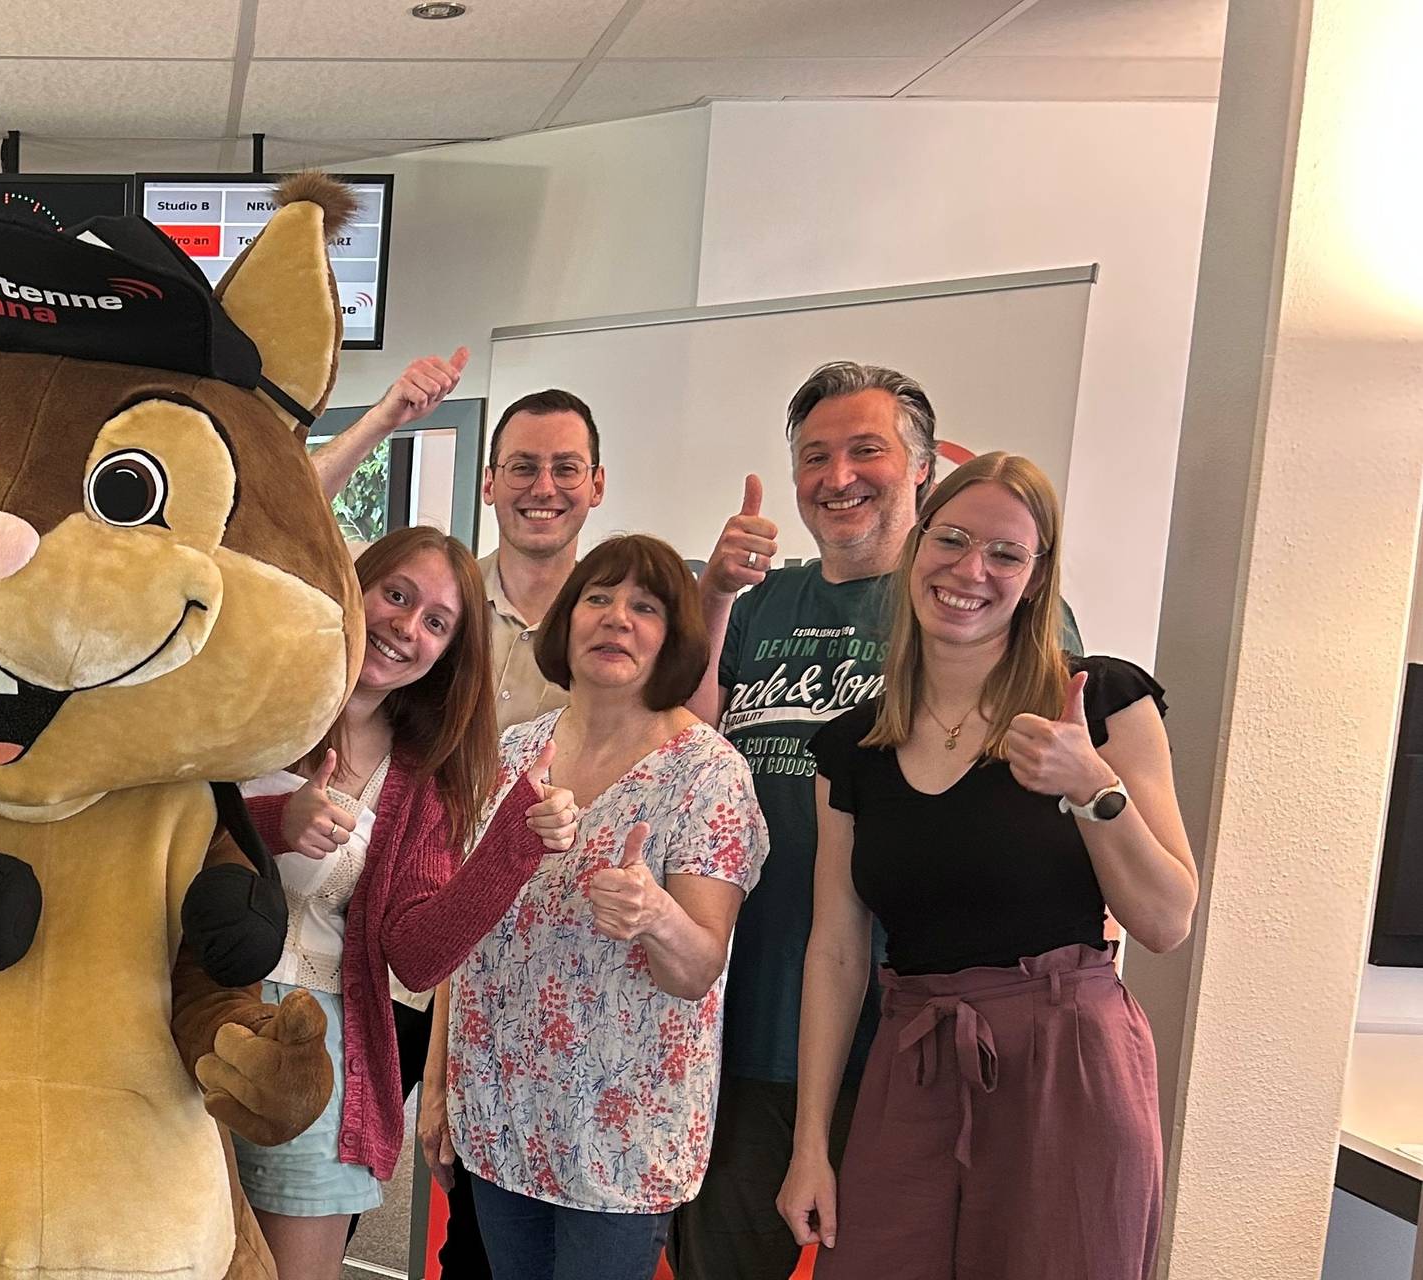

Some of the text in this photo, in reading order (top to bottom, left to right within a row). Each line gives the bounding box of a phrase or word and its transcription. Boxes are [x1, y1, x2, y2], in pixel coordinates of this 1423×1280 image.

[157, 201, 210, 211] Studio B
[193, 237, 209, 245] an
[754, 638, 819, 662] DENIM
[785, 664, 823, 703] &
[745, 736, 801, 755] COTTON
[767, 756, 817, 778] GOODS
